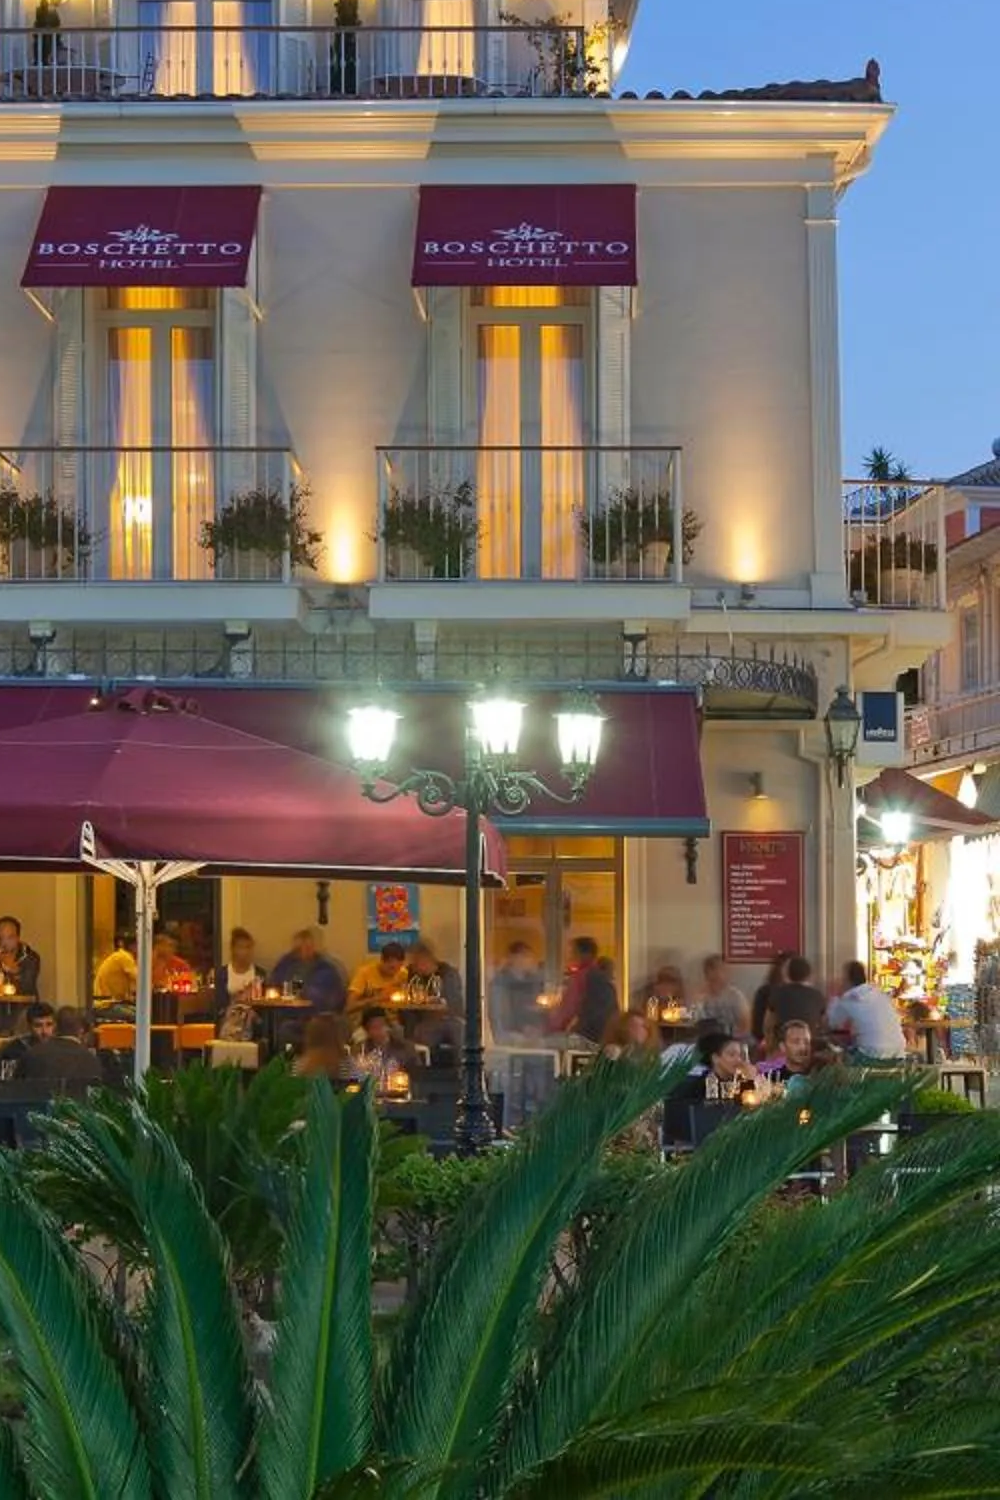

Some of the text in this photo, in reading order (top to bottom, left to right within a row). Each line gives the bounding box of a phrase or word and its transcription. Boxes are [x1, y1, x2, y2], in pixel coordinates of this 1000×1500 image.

[38, 242, 243, 256] BOSCHETTO
[424, 241, 630, 255] BOSCHETTO
[99, 258, 179, 269] HOTEL
[487, 257, 568, 268] HOTEL
